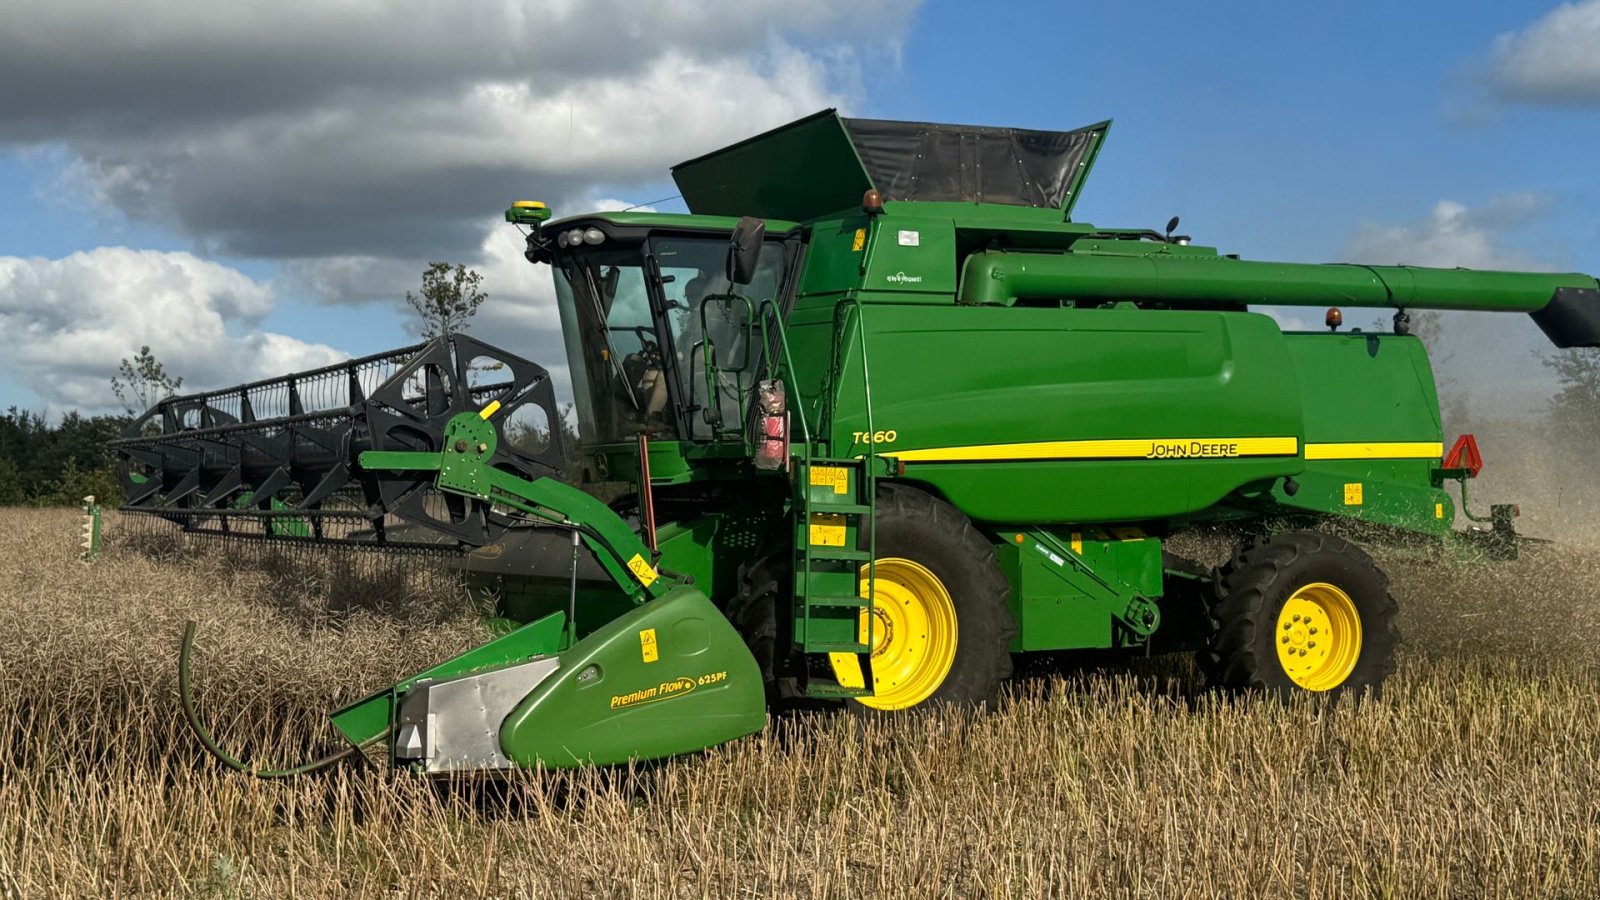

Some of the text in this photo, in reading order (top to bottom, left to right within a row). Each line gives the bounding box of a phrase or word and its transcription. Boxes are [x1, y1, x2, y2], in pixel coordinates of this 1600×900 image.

[852, 430, 897, 444] T660
[1147, 441, 1238, 457] JOHN DEERE
[610, 671, 727, 708] Premium Flow 625PF
